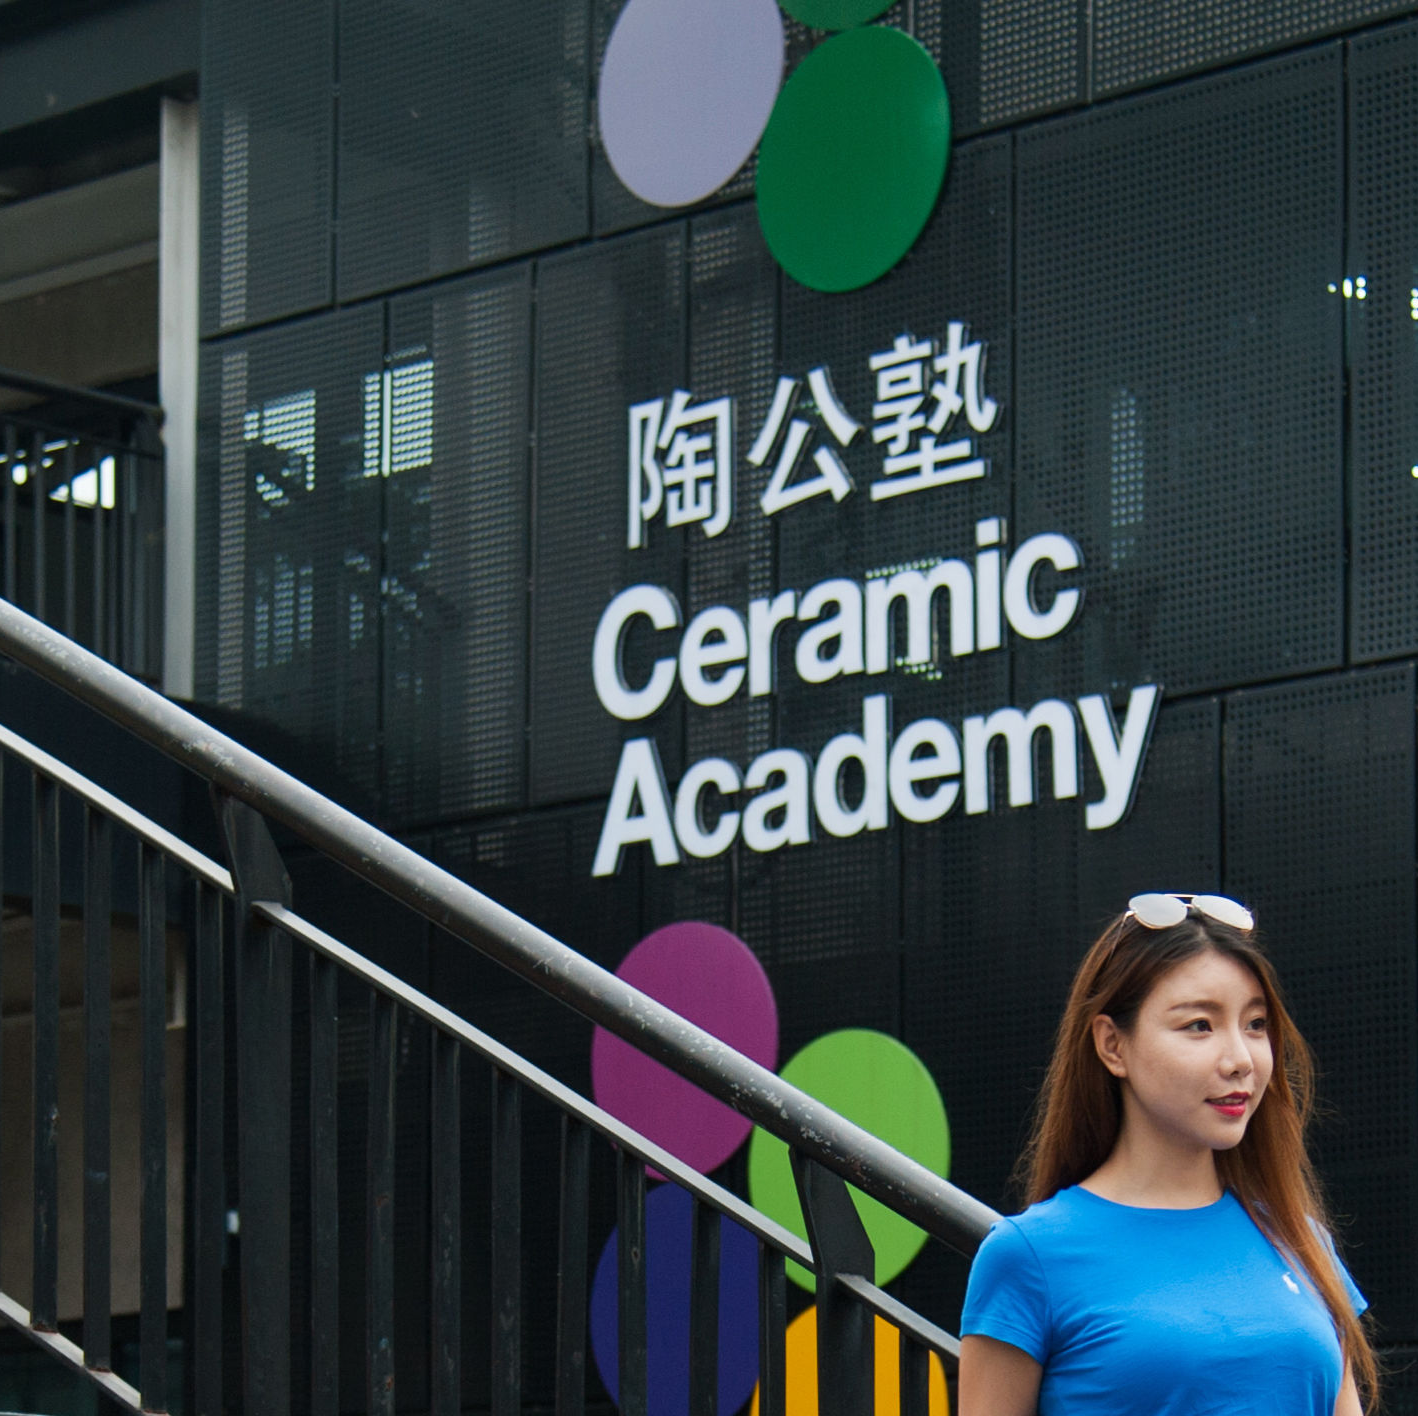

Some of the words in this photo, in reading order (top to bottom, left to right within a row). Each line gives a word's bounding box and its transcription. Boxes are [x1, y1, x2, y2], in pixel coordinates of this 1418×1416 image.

[627, 321, 999, 549] 陶公塾
[592, 517, 1081, 721] Ceramic
[591, 684, 1160, 877] Academy
